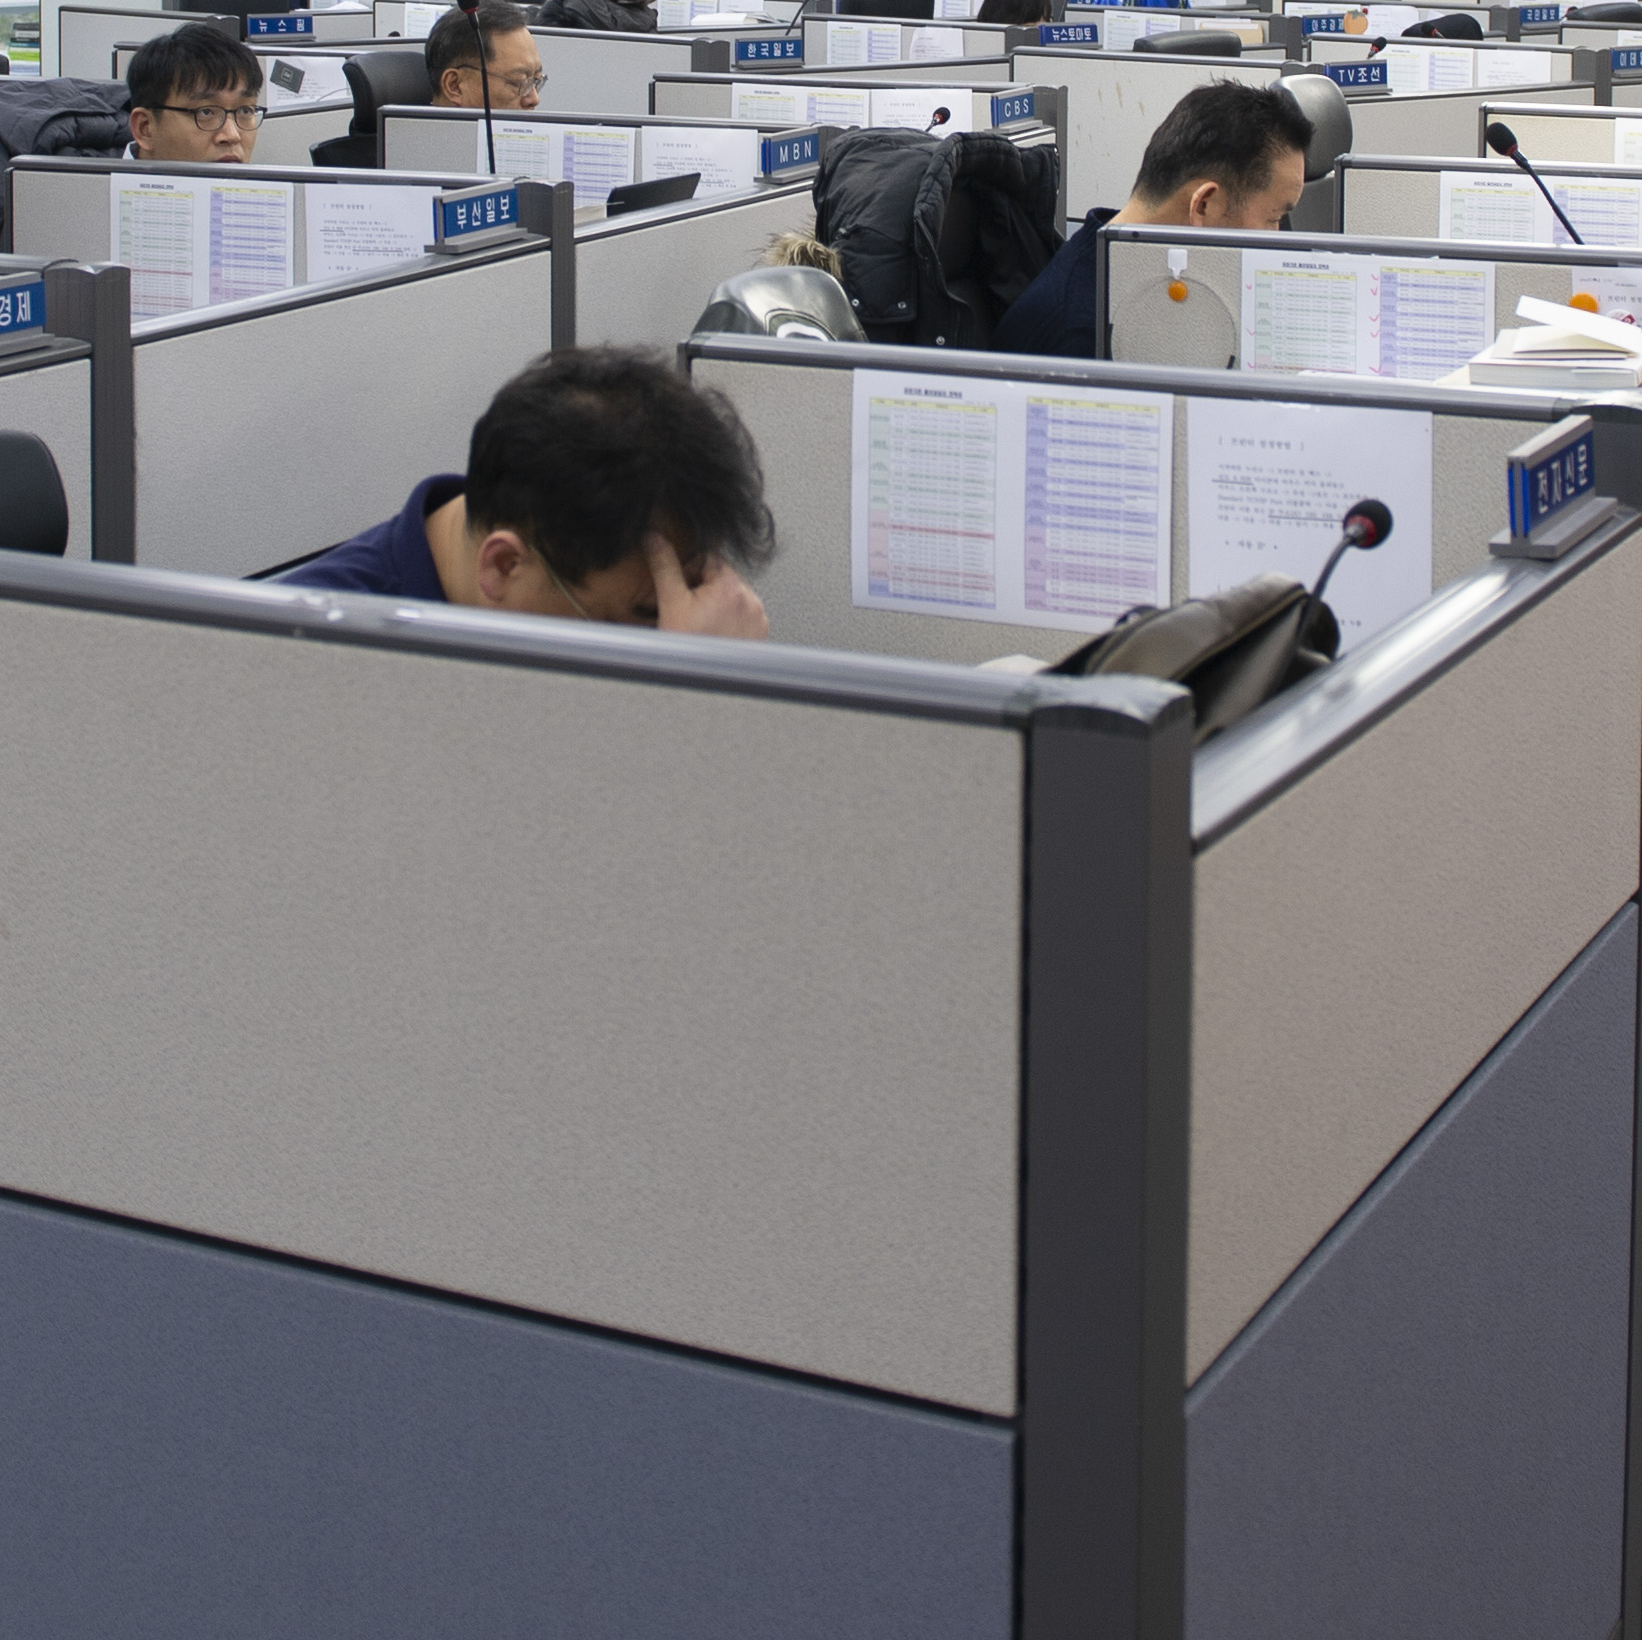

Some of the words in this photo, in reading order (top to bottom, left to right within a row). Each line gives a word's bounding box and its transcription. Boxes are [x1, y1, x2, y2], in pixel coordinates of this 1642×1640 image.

[259, 18, 305, 33] 뉴스핌
[1051, 27, 1092, 41] 뉴스토마토
[747, 42, 795, 59] 한국일보
[1338, 66, 1381, 83] TV조선
[1004, 98, 1029, 118] CBS
[779, 140, 812, 164] MBN
[456, 194, 510, 230] 부산일보
[1537, 444, 1588, 515] 전자신문
